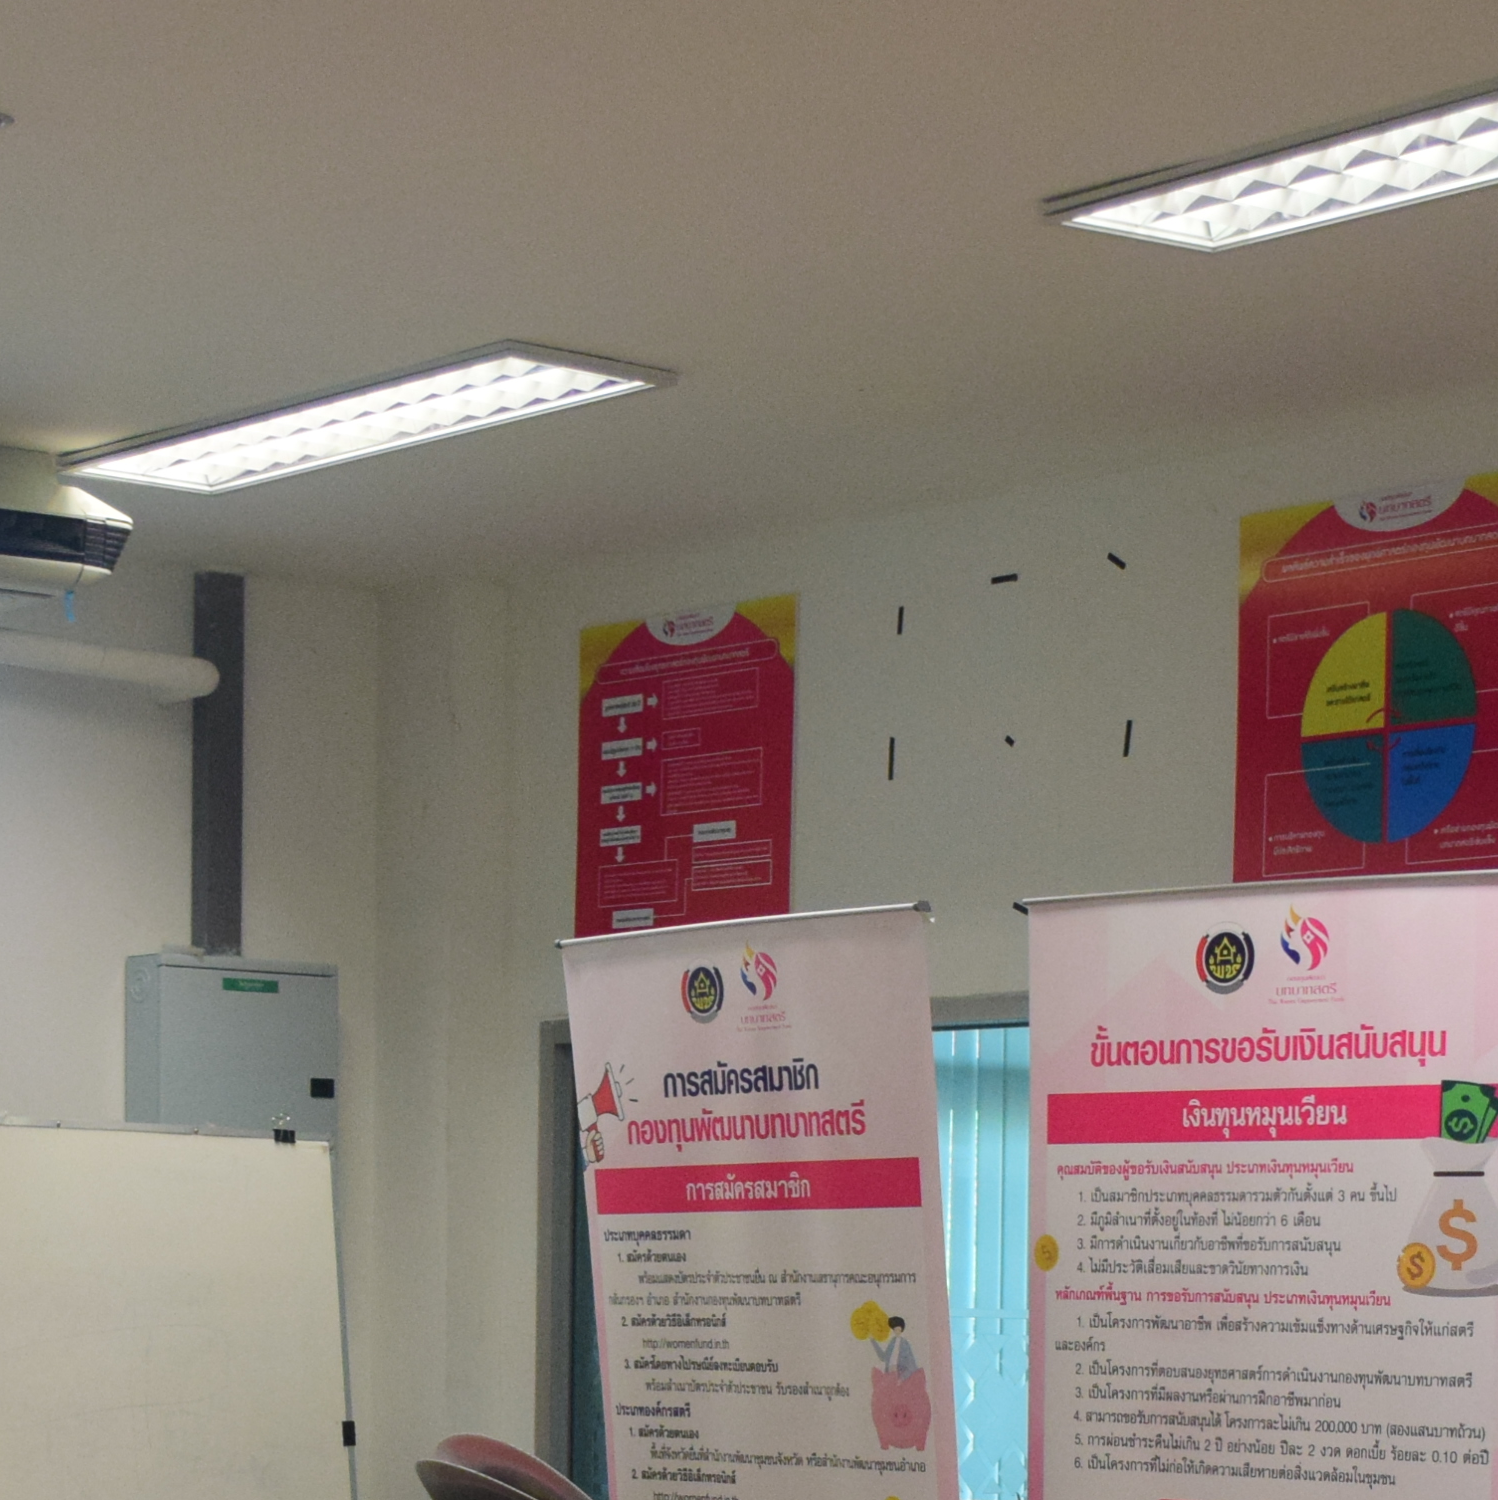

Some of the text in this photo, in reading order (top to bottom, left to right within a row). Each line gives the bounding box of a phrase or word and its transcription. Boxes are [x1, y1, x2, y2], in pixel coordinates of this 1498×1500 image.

[1089, 1023, 1447, 1068] ขั้นตอนการขอรับเงินสนับสนุน
[663, 1058, 819, 1098] การสมัครสมาชิก
[627, 1100, 867, 1152] กองทุนพัฒนาบทบาทสตรี
[1182, 1095, 1348, 1138] เงินทุนหมุนเวียน
[1226, 1158, 1354, 1182] ประเภทเงินทุนหมุนเวียน
[685, 1172, 811, 1201] การสมัครสมาชิก
[1079, 1191, 1086, 1203] 1.
[1338, 1190, 1345, 1202] 3
[1350, 1191, 1365, 1203] คน
[1369, 1175, 1397, 1202] ขึ้นไป
[1077, 1214, 1086, 1226] 2.
[1222, 1210, 1277, 1227] ไม่น้อยกว่า
[1280, 1214, 1288, 1226] 6
[1293, 1212, 1321, 1227] เดือน
[1077, 1238, 1086, 1249] 3.
[1077, 1262, 1086, 1273] 4.
[1146, 1288, 1259, 1309] การขอรับการสนับสนุน
[1077, 1317, 1084, 1328] 1.
[1089, 1314, 1212, 1332] เป็นโครงการพัฒนาอาชีพ
[1054, 1336, 1106, 1353] และองค์กร
[1075, 1364, 1084, 1375] 2.
[1075, 1387, 1084, 1398] 3.
[1074, 1411, 1083, 1422] 4.
[1225, 1415, 1311, 1434] โครงการละไม่เกิน
[1361, 1423, 1382, 1436] บาท
[1386, 1422, 1486, 1442] (สองแสนบาทถ้วน)
[1074, 1433, 1083, 1446] 5.
[1204, 1439, 1211, 1452] 2
[1215, 1436, 1223, 1453] ปี
[1227, 1437, 1274, 1456] อย่างน้อย
[1280, 1440, 1303, 1457] ปีละ
[1308, 1443, 1315, 1456] 2
[1320, 1444, 1341, 1459] งวด
[1346, 1438, 1386, 1461] ดอกเบี้ย
[1390, 1443, 1426, 1462] ร้อยละ
[1432, 1449, 1458, 1464] 0.10
[1462, 1448, 1489, 1466] ต่อปี
[1074, 1458, 1083, 1470] 6.
